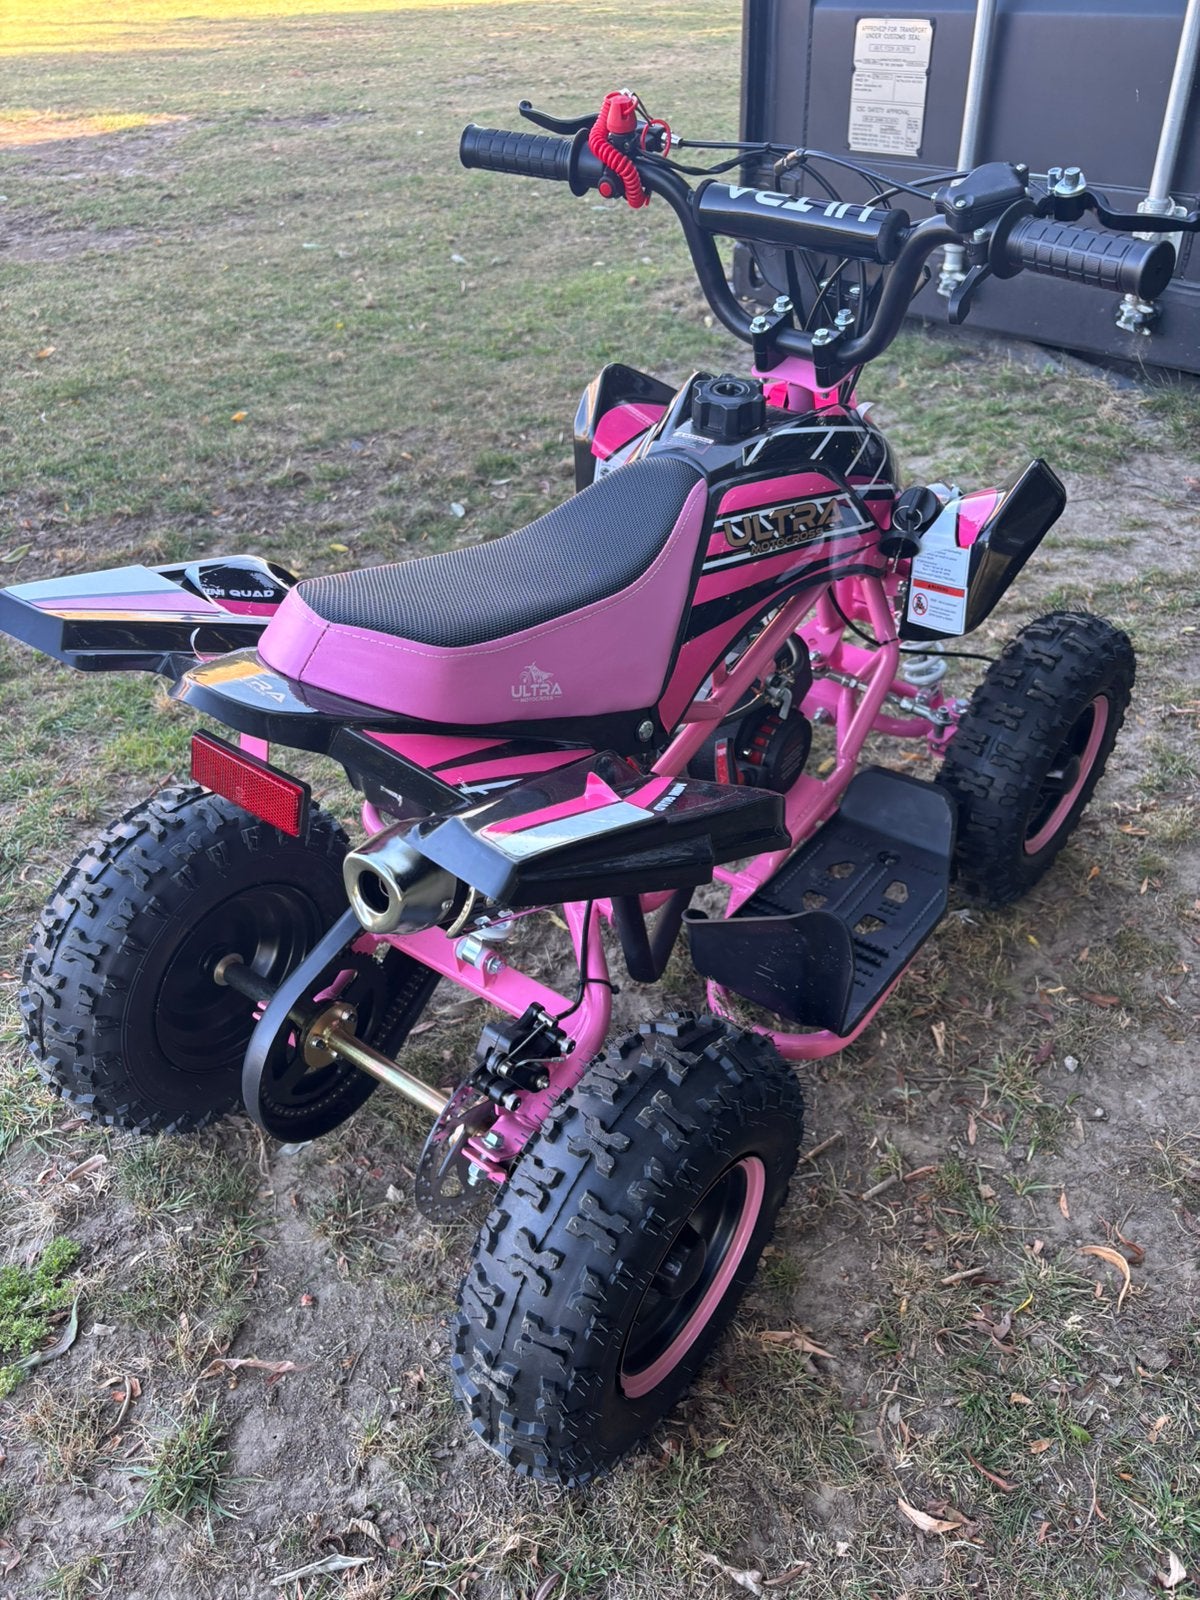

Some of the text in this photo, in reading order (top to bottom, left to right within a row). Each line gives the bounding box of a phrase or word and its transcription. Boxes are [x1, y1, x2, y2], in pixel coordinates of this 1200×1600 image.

[899, 26, 929, 34] TRANSPORT
[856, 105, 910, 116] CSC SAFETY APPROVAL
[723, 497, 844, 548] ULTRA
[751, 527, 824, 556] MOTOCROSS
[228, 589, 275, 598] QUAD
[511, 682, 563, 699] ULTRA
